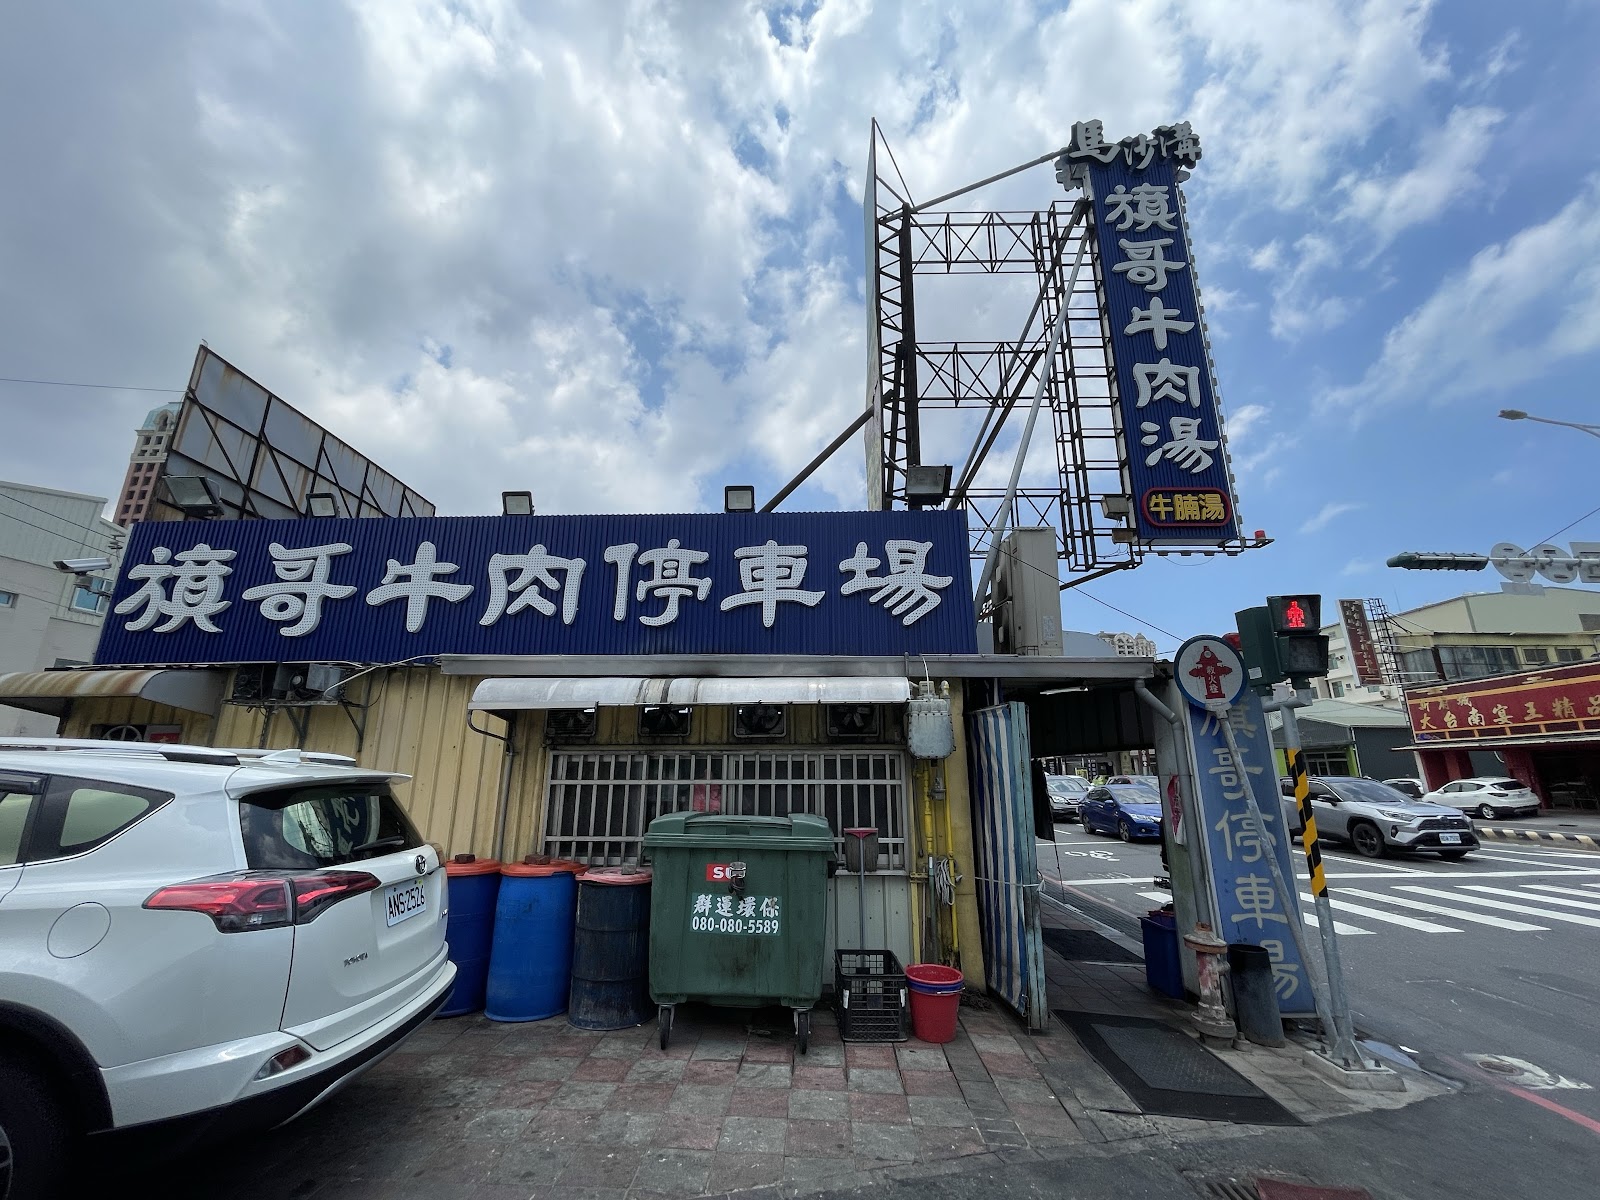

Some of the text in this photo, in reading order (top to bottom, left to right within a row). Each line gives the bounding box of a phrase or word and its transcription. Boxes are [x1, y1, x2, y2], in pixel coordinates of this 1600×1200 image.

[1069, 119, 1202, 169] 馬沙溝
[1149, 493, 1225, 520] 牛腩湯
[388, 884, 425, 920] ANS-2526
[693, 894, 780, 918] 群運環保
[692, 916, 779, 934] 080-080-5589
